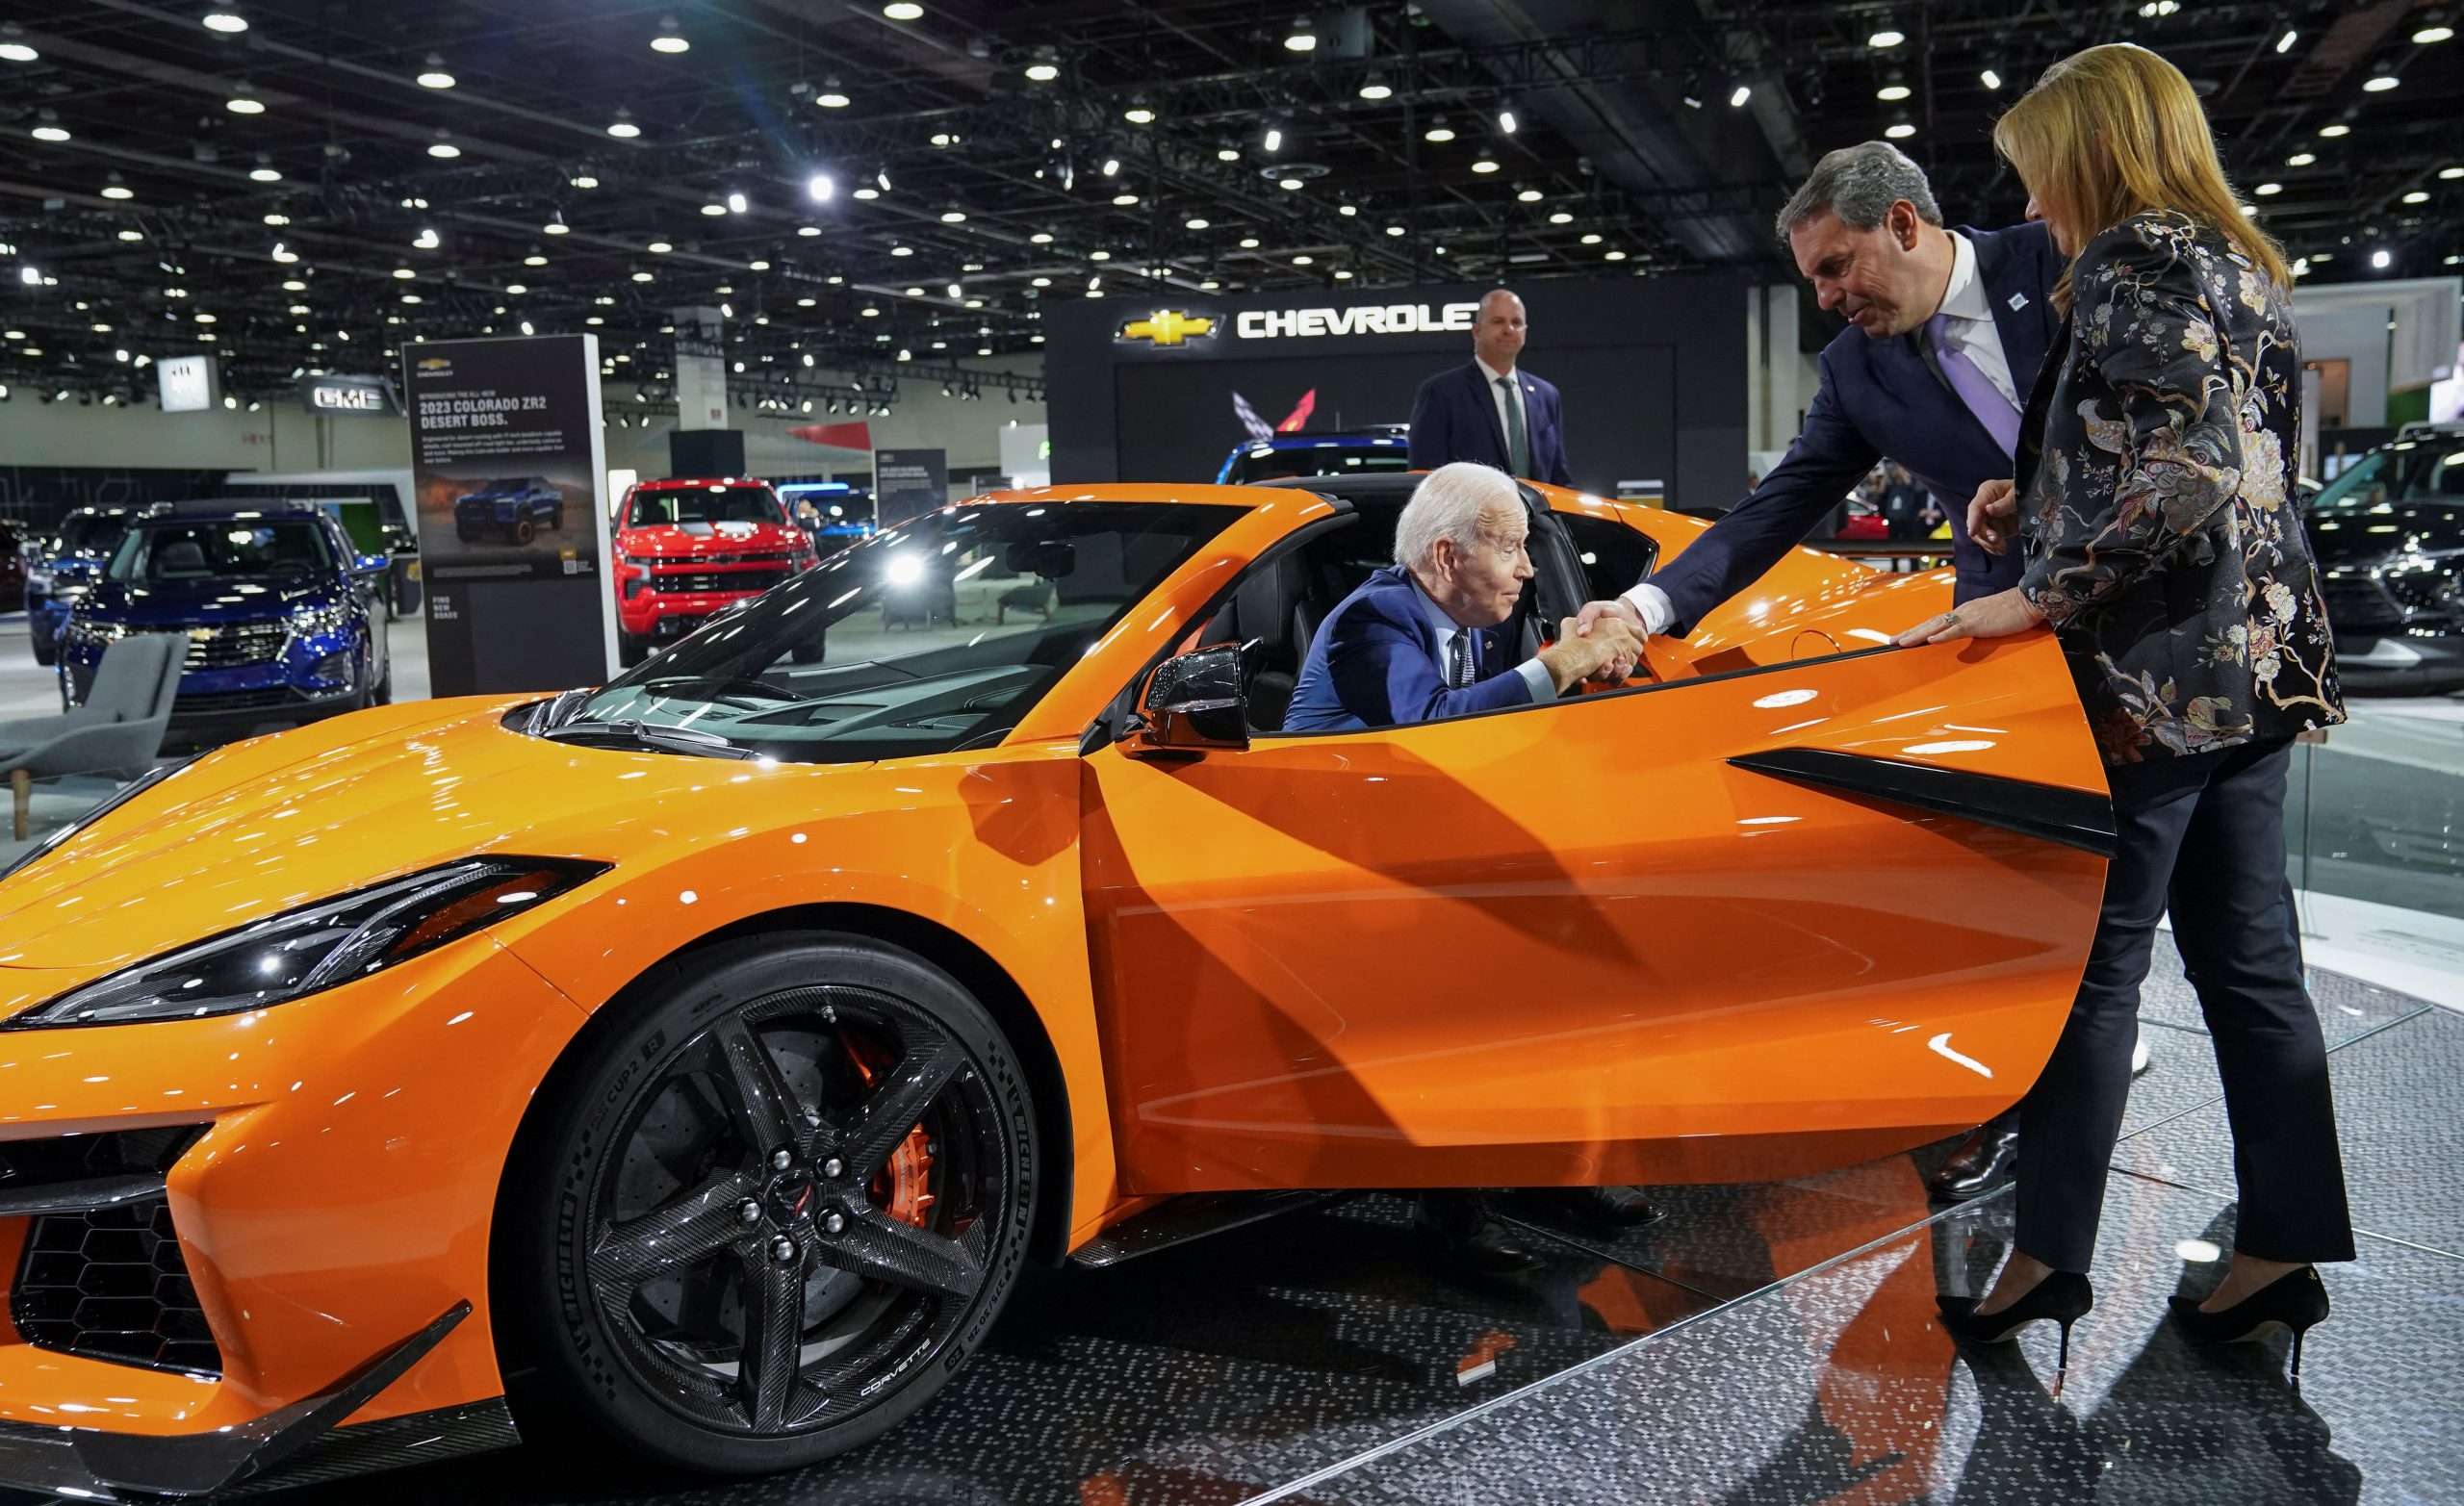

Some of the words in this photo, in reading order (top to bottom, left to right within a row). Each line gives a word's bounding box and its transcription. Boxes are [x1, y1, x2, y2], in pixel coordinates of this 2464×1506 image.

[1237, 302, 1480, 339] CHEVROLE
[314, 386, 384, 410] GMC
[420, 400, 451, 415] 2023
[453, 397, 520, 413] COLORADO
[522, 396, 547, 411] ZR2
[421, 415, 469, 429] DESERT
[471, 413, 508, 426] BOSS.
[433, 596, 450, 604] FIND
[607, 1069, 630, 1103] CUP
[629, 1060, 640, 1075] 2
[646, 1037, 661, 1054] R
[1014, 1115, 1031, 1222] MICHELIN
[558, 1198, 580, 1322] MICHELIN
[979, 1279, 1005, 1325] 275/30
[966, 1324, 981, 1342] ZR
[860, 1338, 931, 1396] CORVETTE
[948, 1349, 962, 1366] 20
